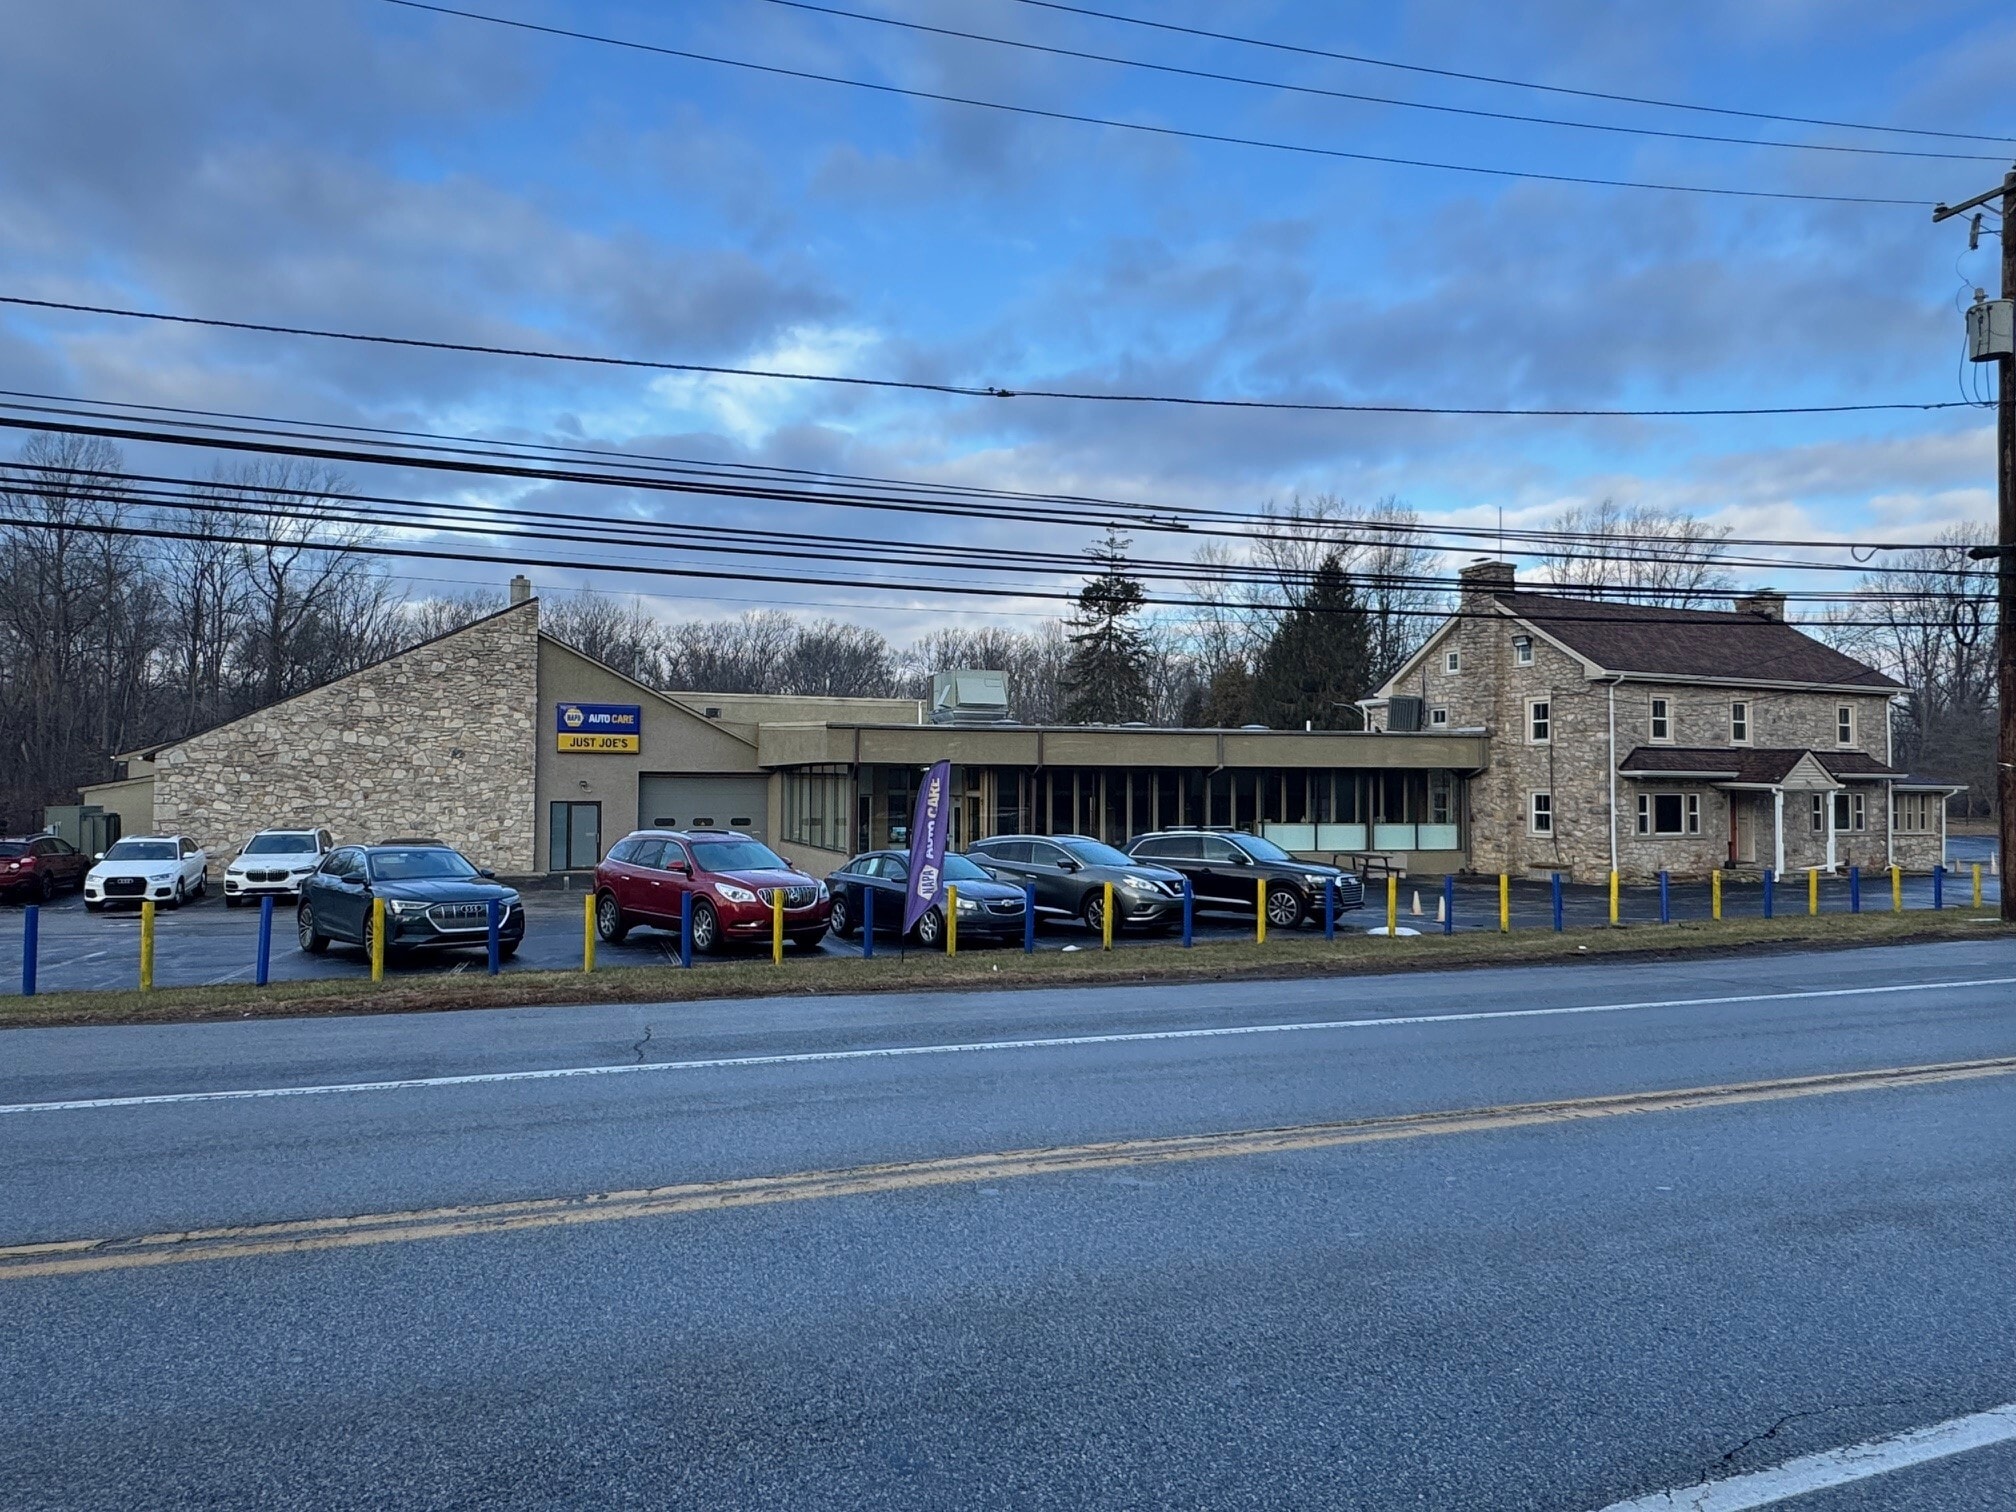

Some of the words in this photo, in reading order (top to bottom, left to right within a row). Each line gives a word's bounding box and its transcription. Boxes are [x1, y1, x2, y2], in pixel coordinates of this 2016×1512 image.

[589, 714, 610, 723] AUTO
[611, 715, 634, 724] CARE
[570, 737, 596, 747] JUST
[599, 738, 628, 748] JOE'S
[927, 777, 940, 818] CARE
[922, 870, 935, 895] NAPA
